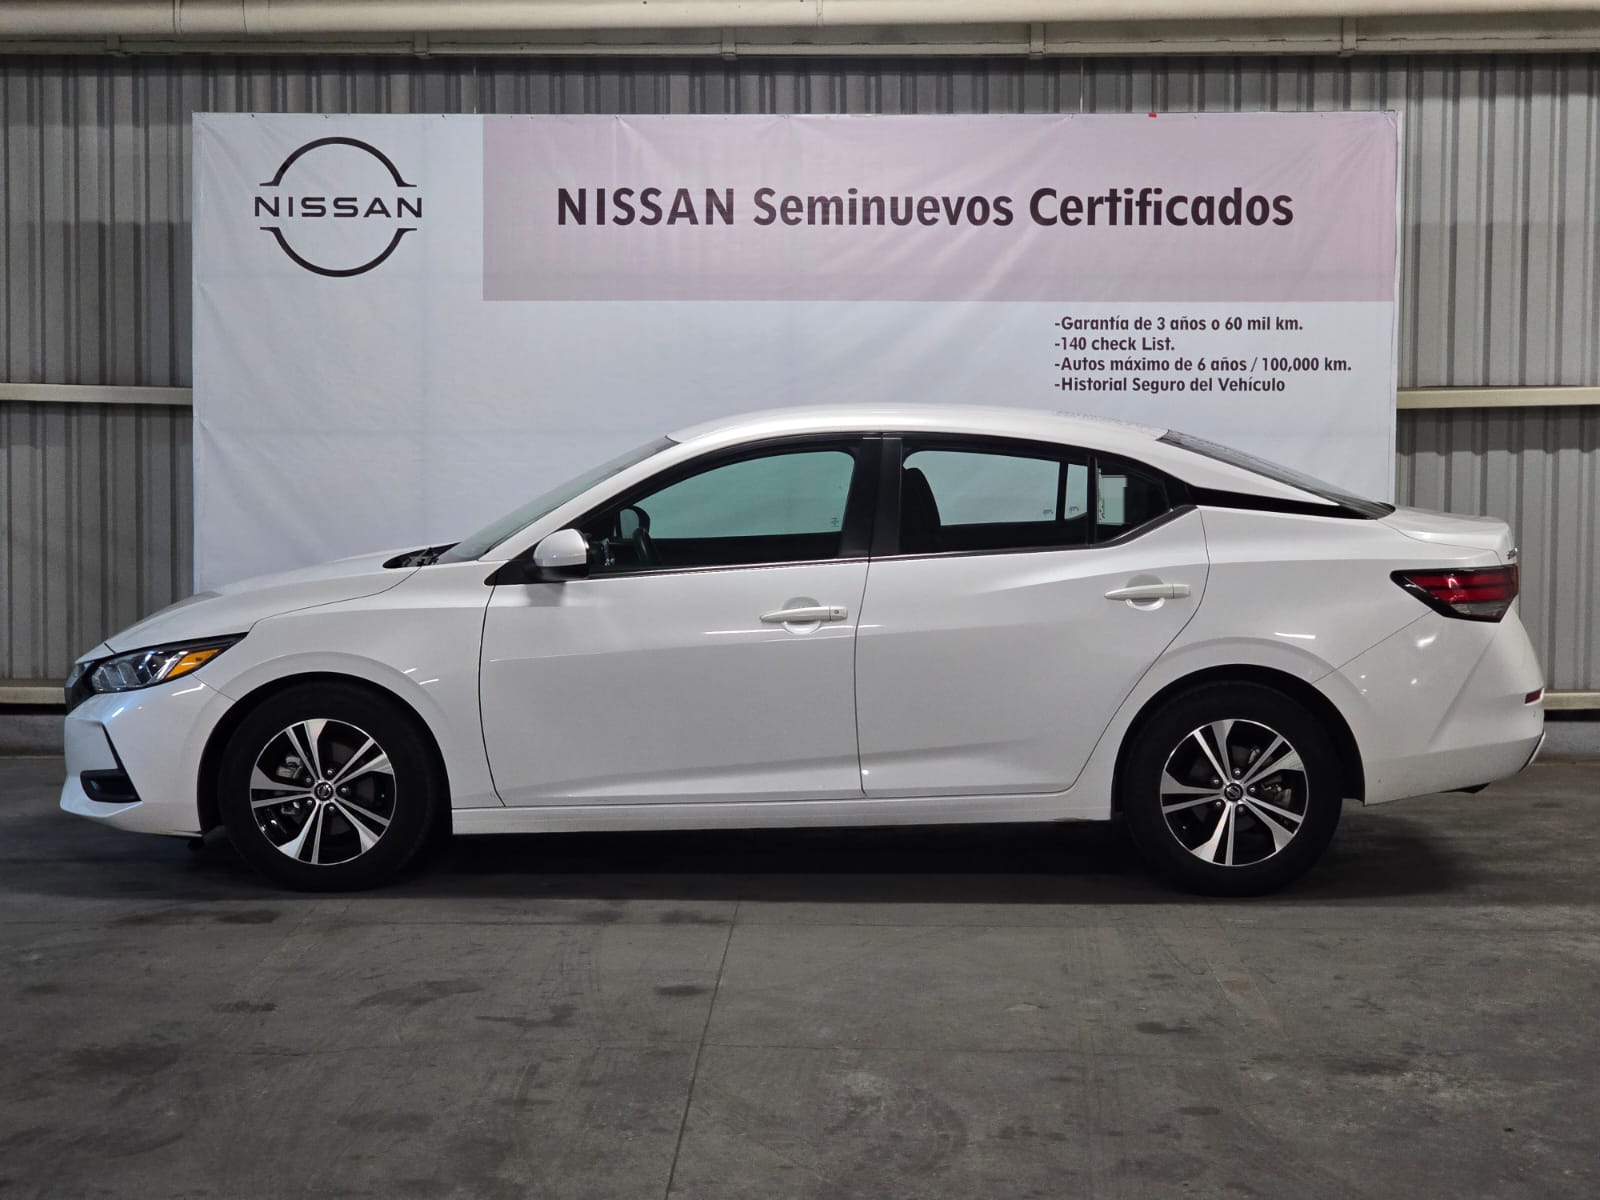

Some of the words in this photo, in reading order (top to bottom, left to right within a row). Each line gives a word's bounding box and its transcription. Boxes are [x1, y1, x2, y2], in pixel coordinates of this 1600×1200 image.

[254, 196, 423, 219] NISSAN
[557, 187, 734, 226] NISSAN
[754, 187, 1014, 227] Seminuevos
[1029, 186, 1294, 227] Certificados
[1055, 315, 1129, 331] -Garantía
[1134, 316, 1152, 331] de
[1157, 316, 1166, 331] 3
[1170, 315, 1207, 331] años
[1211, 319, 1221, 331] o
[1225, 316, 1243, 331] 60
[1247, 316, 1271, 331] mil
[1276, 316, 1304, 331] km.
[1055, 336, 1087, 351] -140
[1091, 336, 1137, 351] check
[1142, 336, 1175, 351] List.
[1055, 356, 1105, 372] -Autos
[1110, 355, 1170, 372] máximo
[1175, 356, 1193, 372] de
[1198, 357, 1207, 372] 6
[1210, 356, 1248, 372] años
[1250, 356, 1258, 373] /
[1262, 357, 1320, 373] 100,000
[1325, 356, 1352, 372] km.
[1055, 376, 1127, 392] -Historial
[1132, 377, 1186, 395] Seguro
[1190, 377, 1213, 392] del
[1218, 376, 1286, 392] Vehículo
